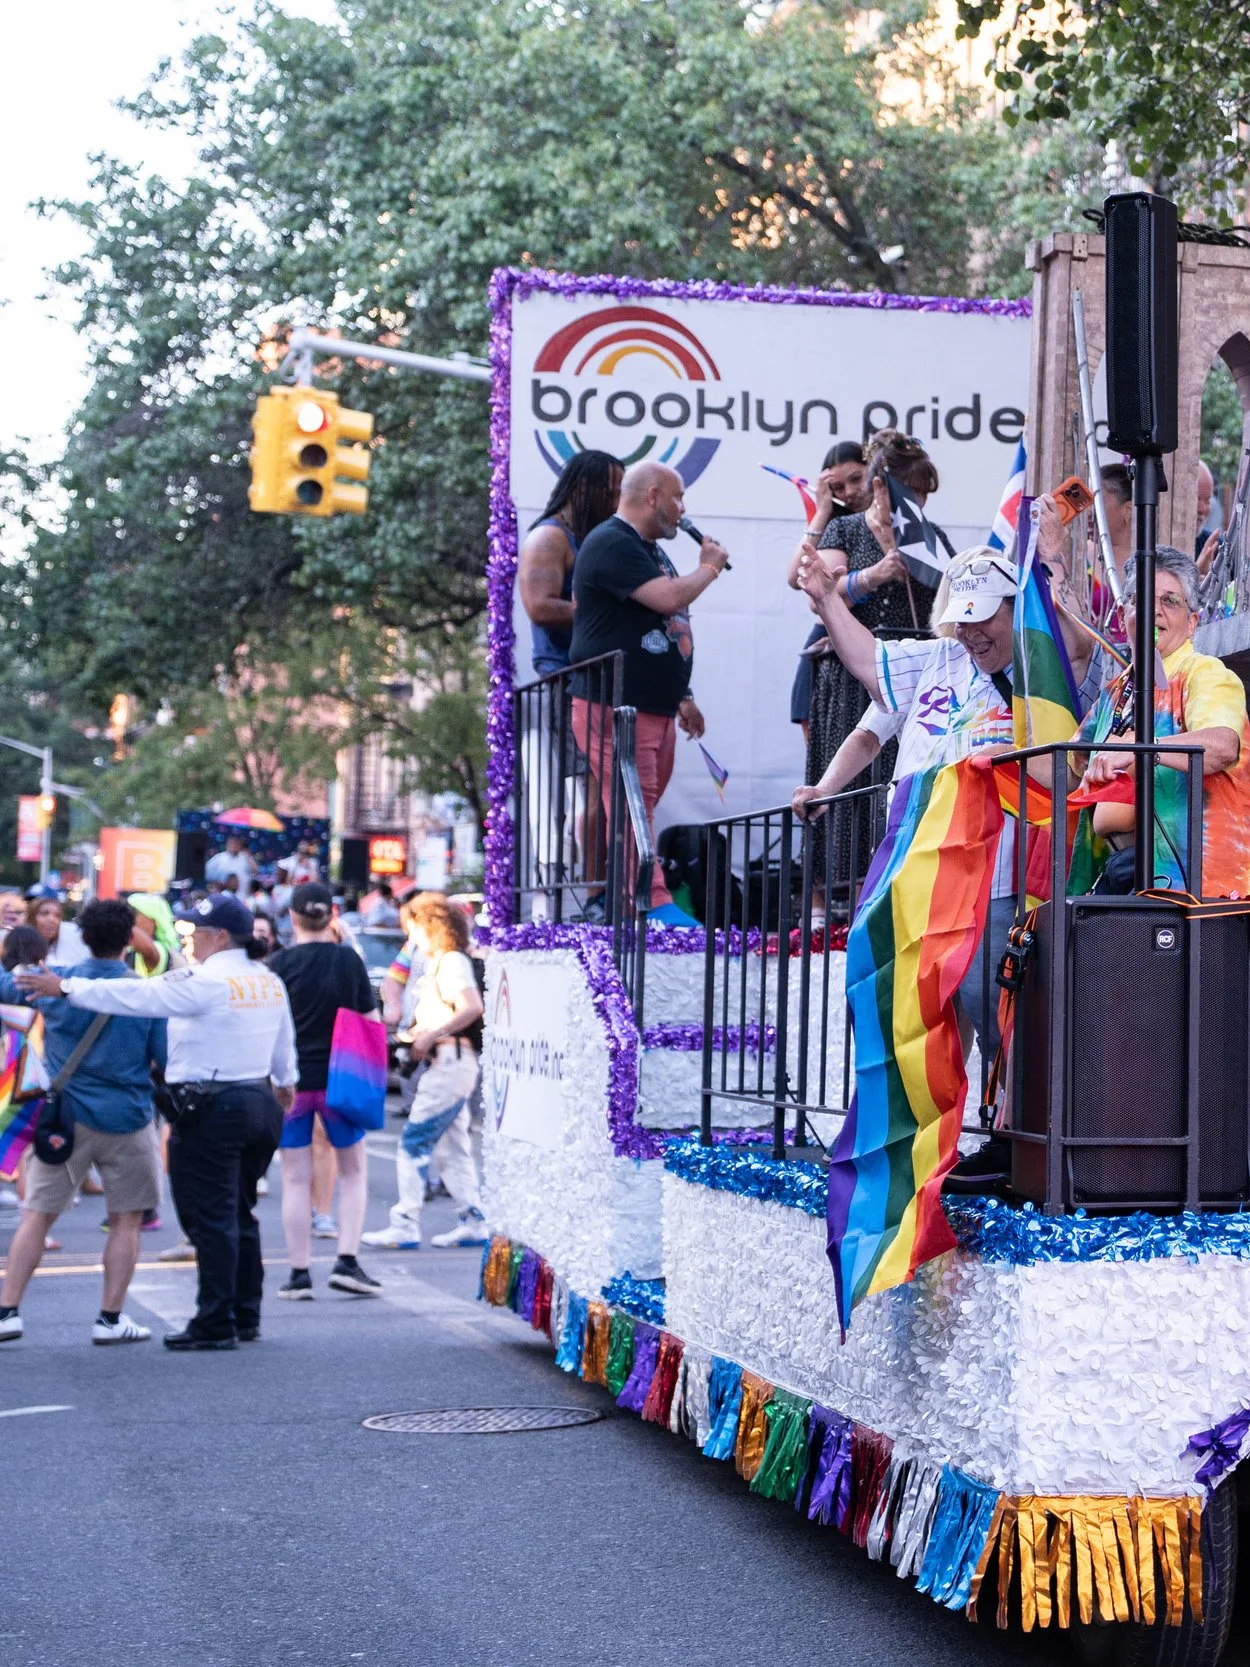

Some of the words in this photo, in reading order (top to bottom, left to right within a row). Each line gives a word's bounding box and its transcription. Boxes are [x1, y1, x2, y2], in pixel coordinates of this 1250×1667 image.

[531, 378, 838, 447] brooklyn
[862, 393, 1026, 443] pride
[1159, 935, 1173, 944] RCF
